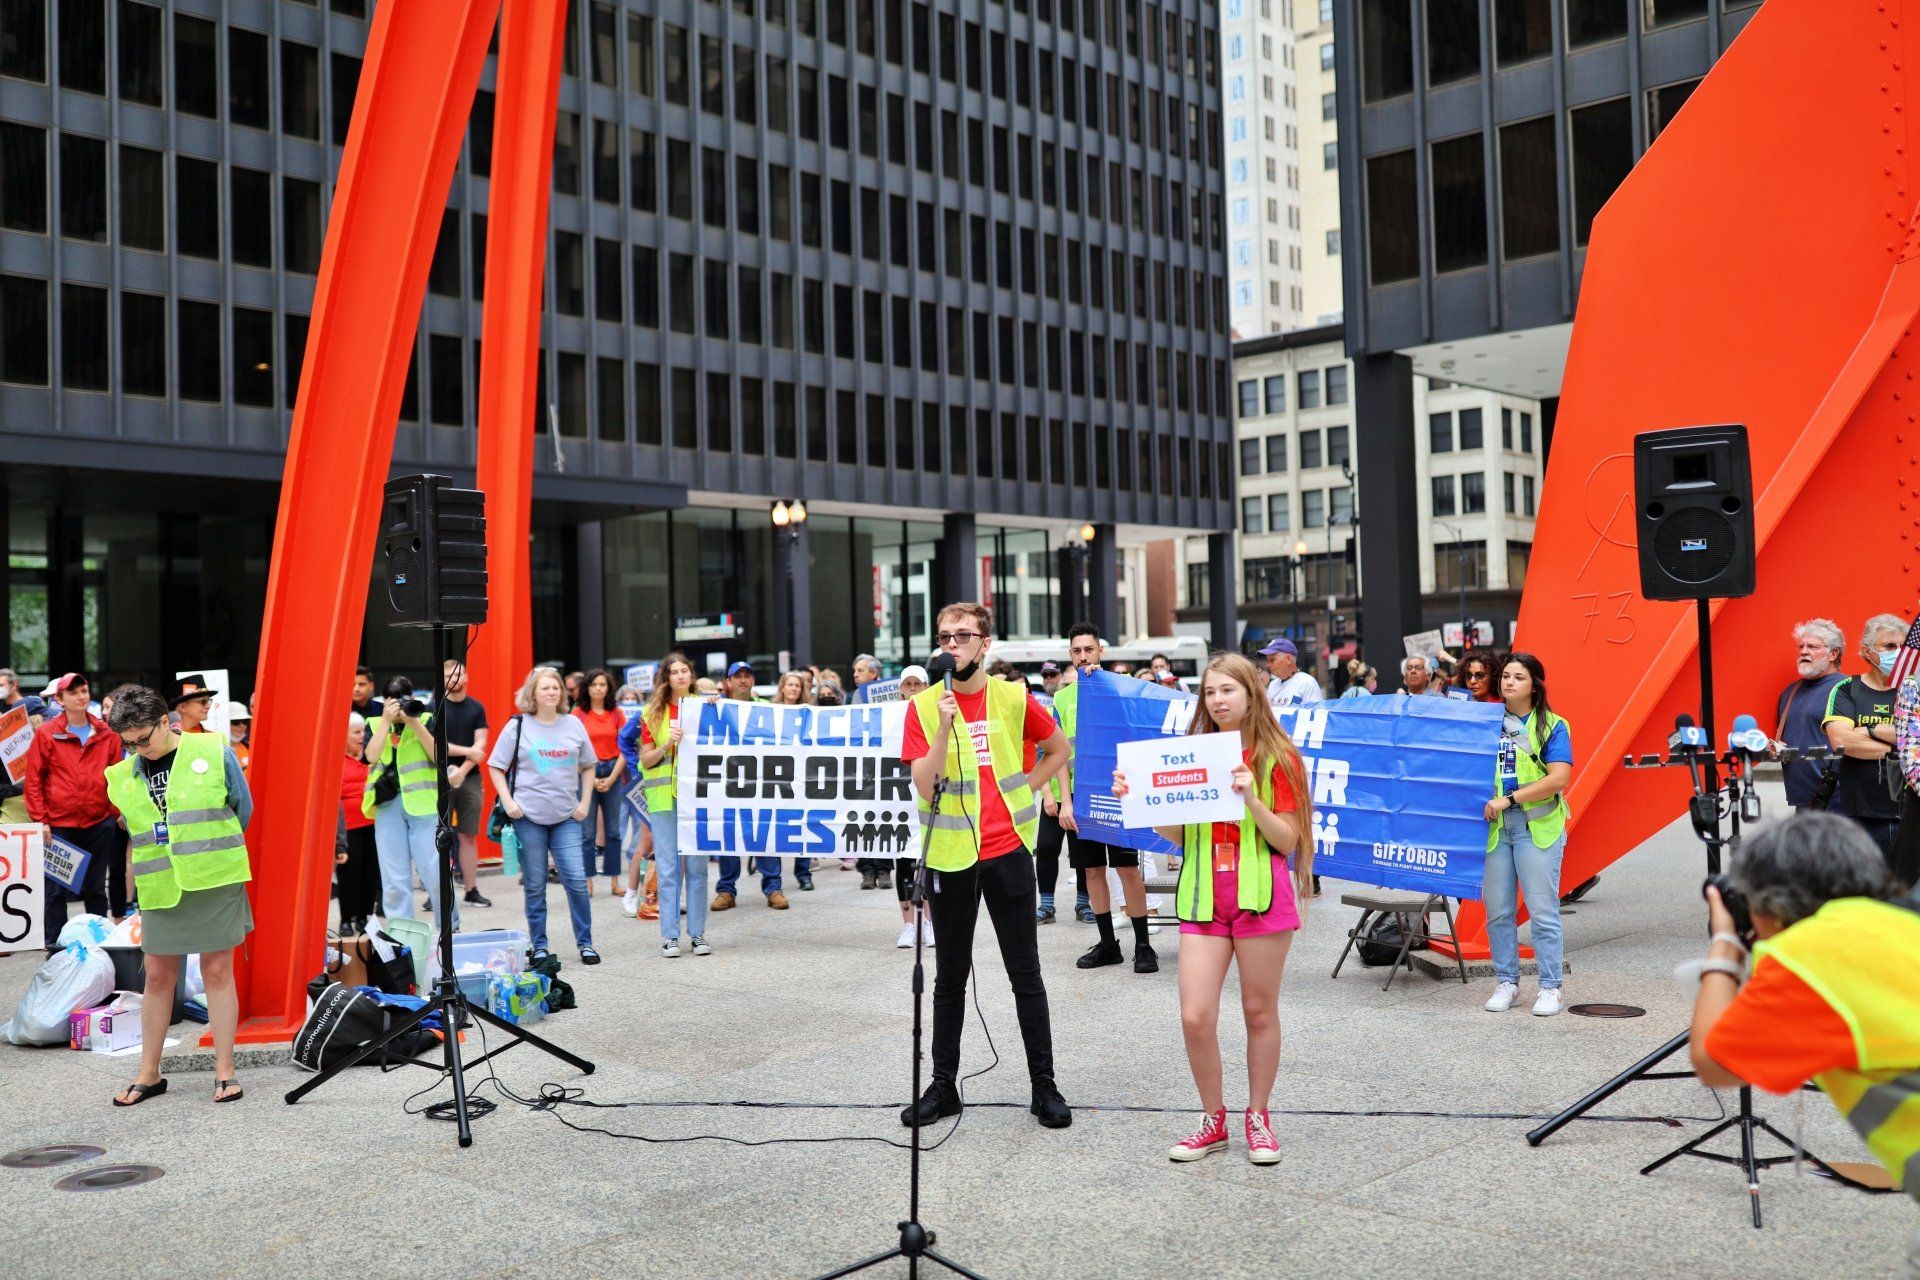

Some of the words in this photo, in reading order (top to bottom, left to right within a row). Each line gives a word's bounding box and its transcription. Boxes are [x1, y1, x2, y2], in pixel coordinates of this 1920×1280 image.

[1571, 590, 1637, 645] 73
[871, 683, 899, 696] MARCH
[696, 701, 883, 748] MARCH
[1687, 727, 1699, 745] 9
[537, 748, 570, 758] Votes
[1161, 752, 1196, 766] Text
[696, 754, 795, 799] FOR
[805, 756, 913, 801] OUR
[1156, 771, 1204, 785] Students
[1145, 794, 1161, 806] to
[1166, 788, 1220, 804] 644-33
[1090, 810, 1124, 822] EVERYTOW
[696, 808, 837, 853] LIVES
[1373, 842, 1448, 868] GIFFORDS
